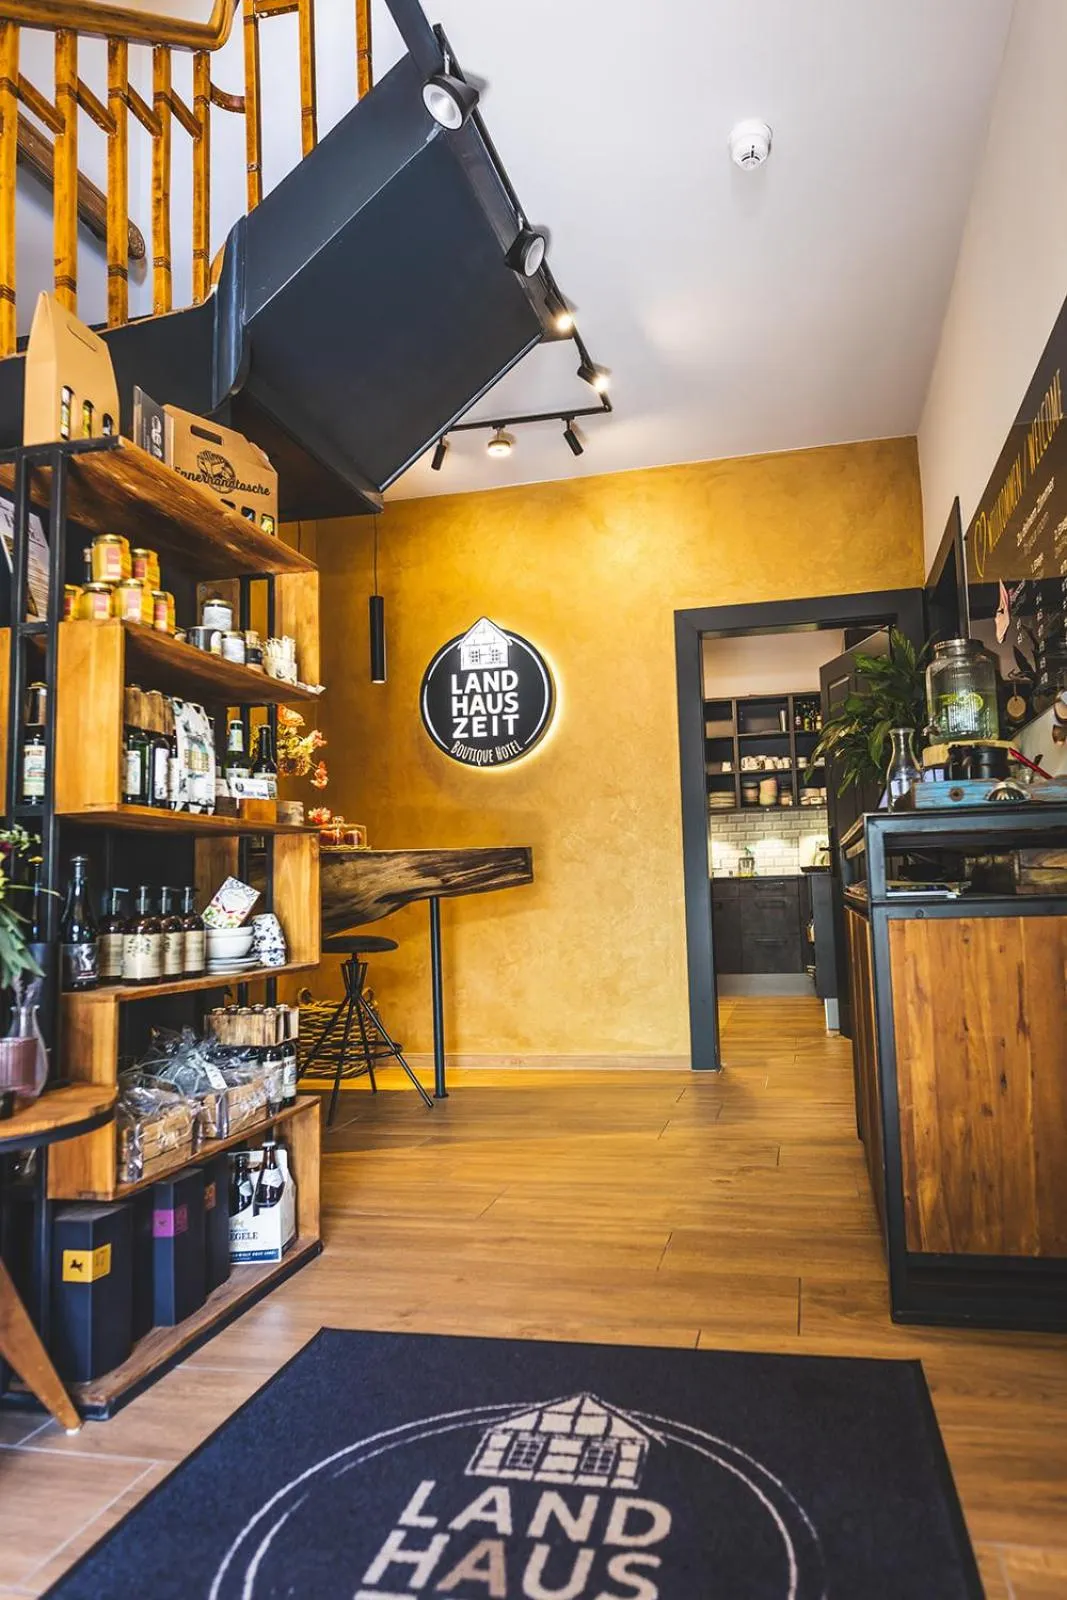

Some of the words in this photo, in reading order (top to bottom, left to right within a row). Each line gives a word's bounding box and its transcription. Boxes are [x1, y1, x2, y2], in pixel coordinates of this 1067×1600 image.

[451, 670, 519, 695] LAND
[452, 692, 519, 717] HAUS
[452, 714, 519, 739] ZEIT
[451, 741, 493, 765] BOUTIQUE
[496, 740, 523, 761] HOTEL
[398, 1479, 673, 1548] LAND
[361, 1529, 662, 1600] HAUS
